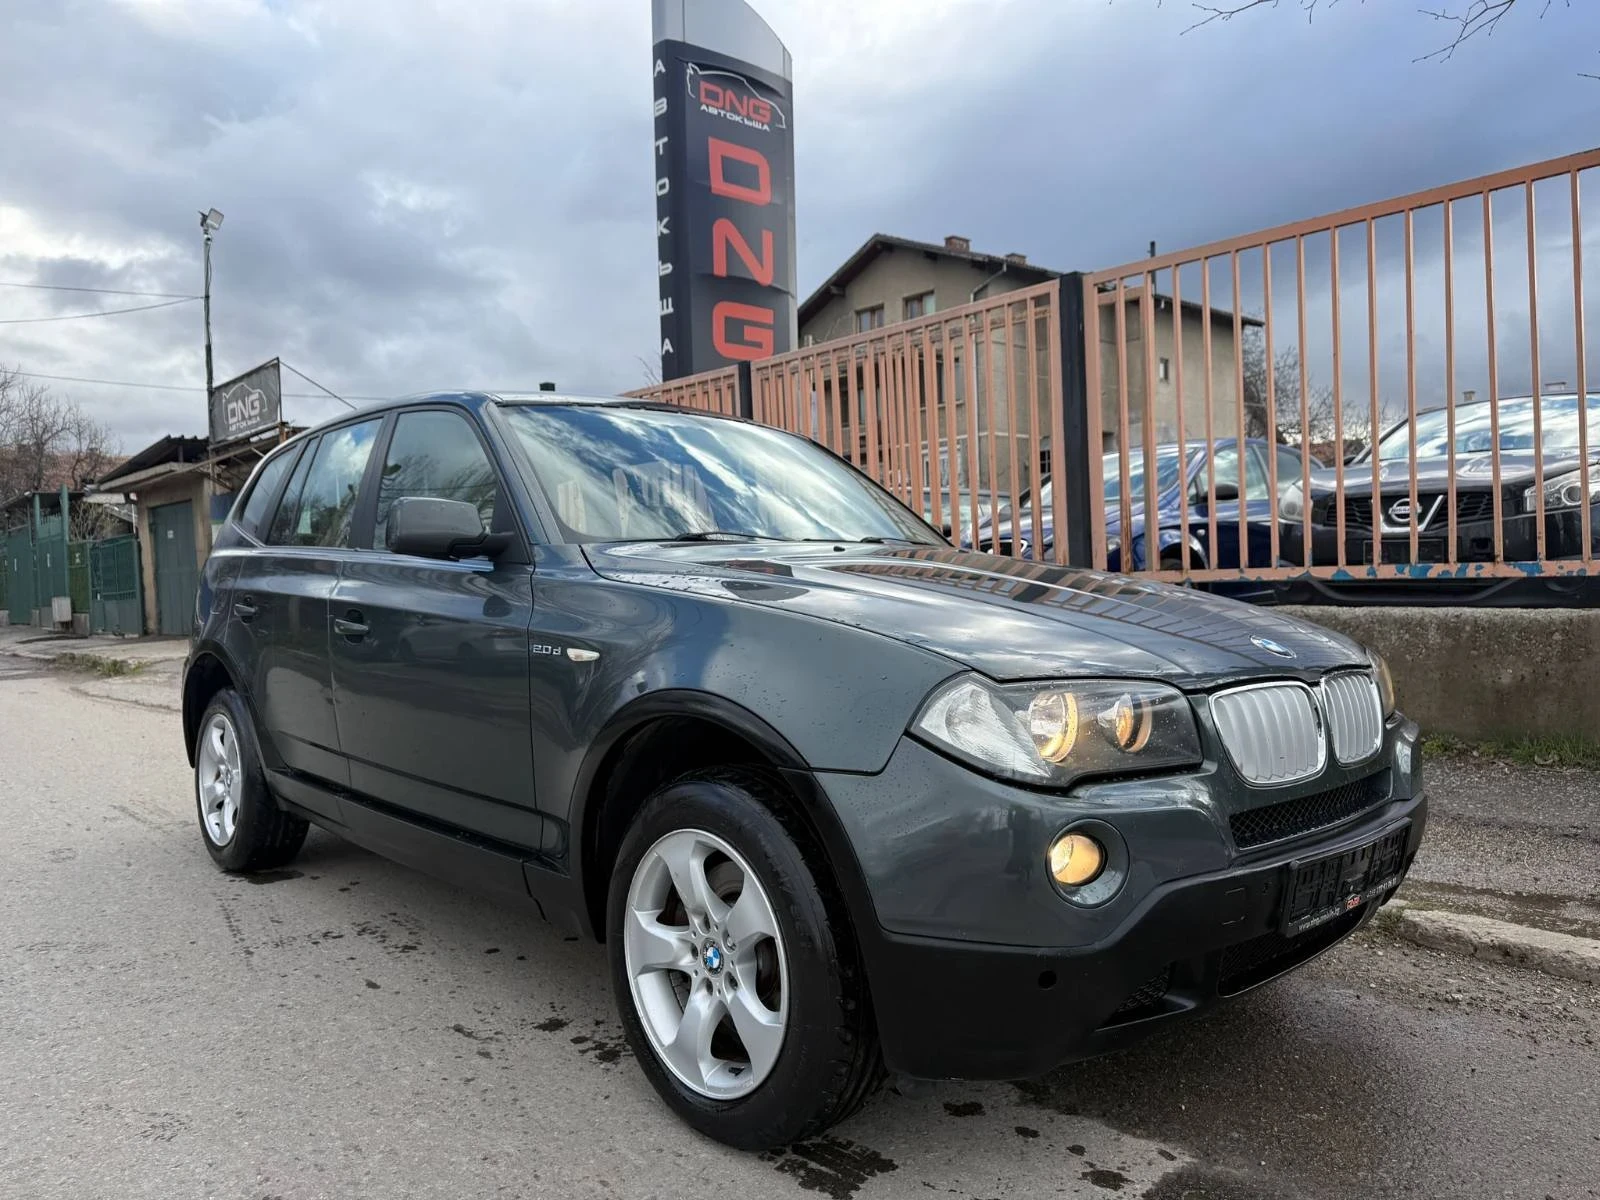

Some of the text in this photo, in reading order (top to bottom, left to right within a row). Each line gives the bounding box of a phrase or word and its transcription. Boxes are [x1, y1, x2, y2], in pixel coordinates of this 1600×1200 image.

[699, 80, 772, 124] DNG
[708, 136, 774, 362] DNG
[227, 392, 260, 424] DNG
